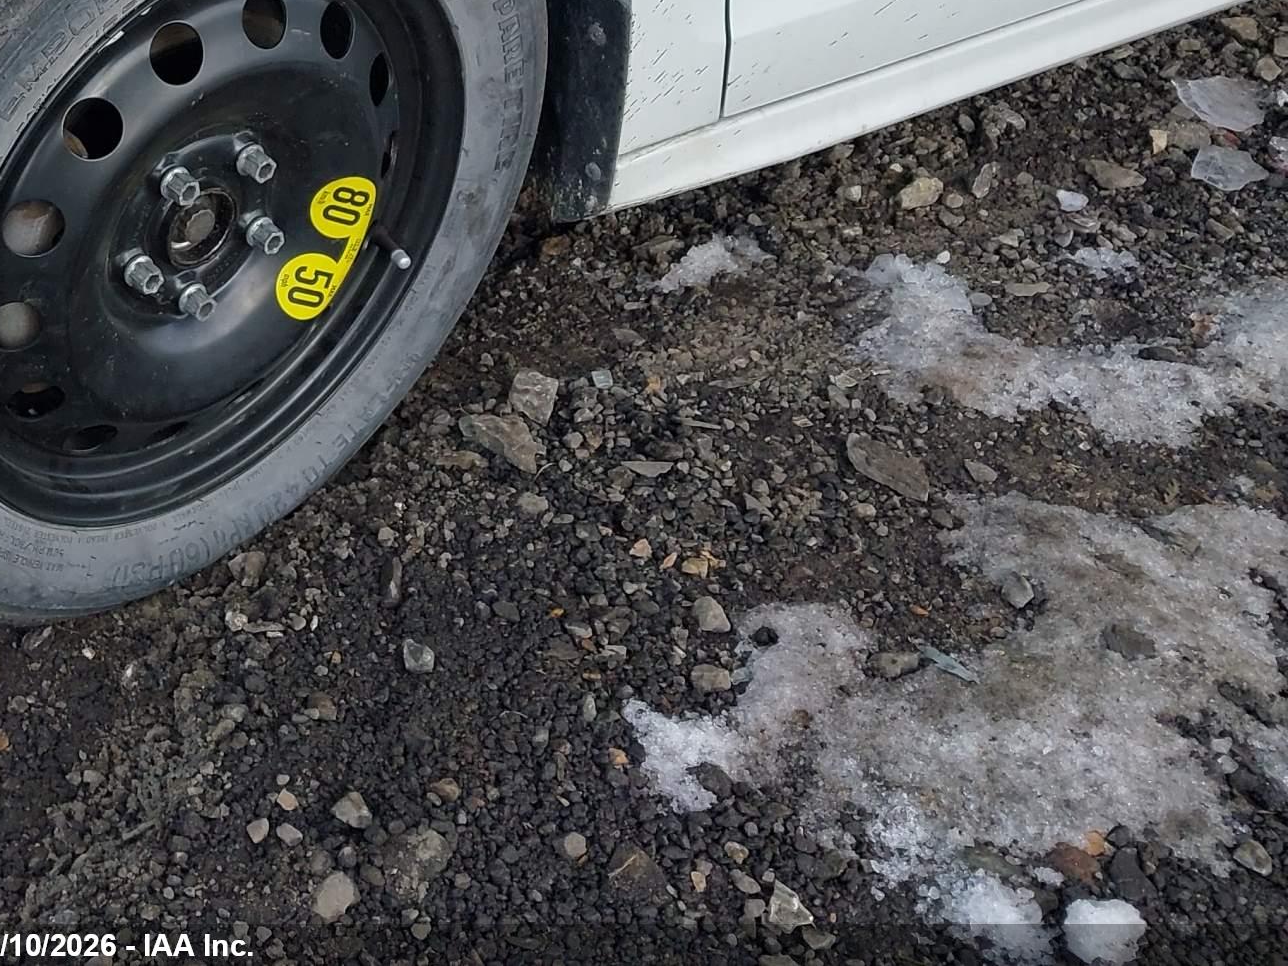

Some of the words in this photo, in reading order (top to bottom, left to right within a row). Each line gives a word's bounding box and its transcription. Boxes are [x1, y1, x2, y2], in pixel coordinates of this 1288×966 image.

[491, 84, 524, 174] TIRE
[322, 186, 370, 226] 80
[287, 266, 334, 308] 50
